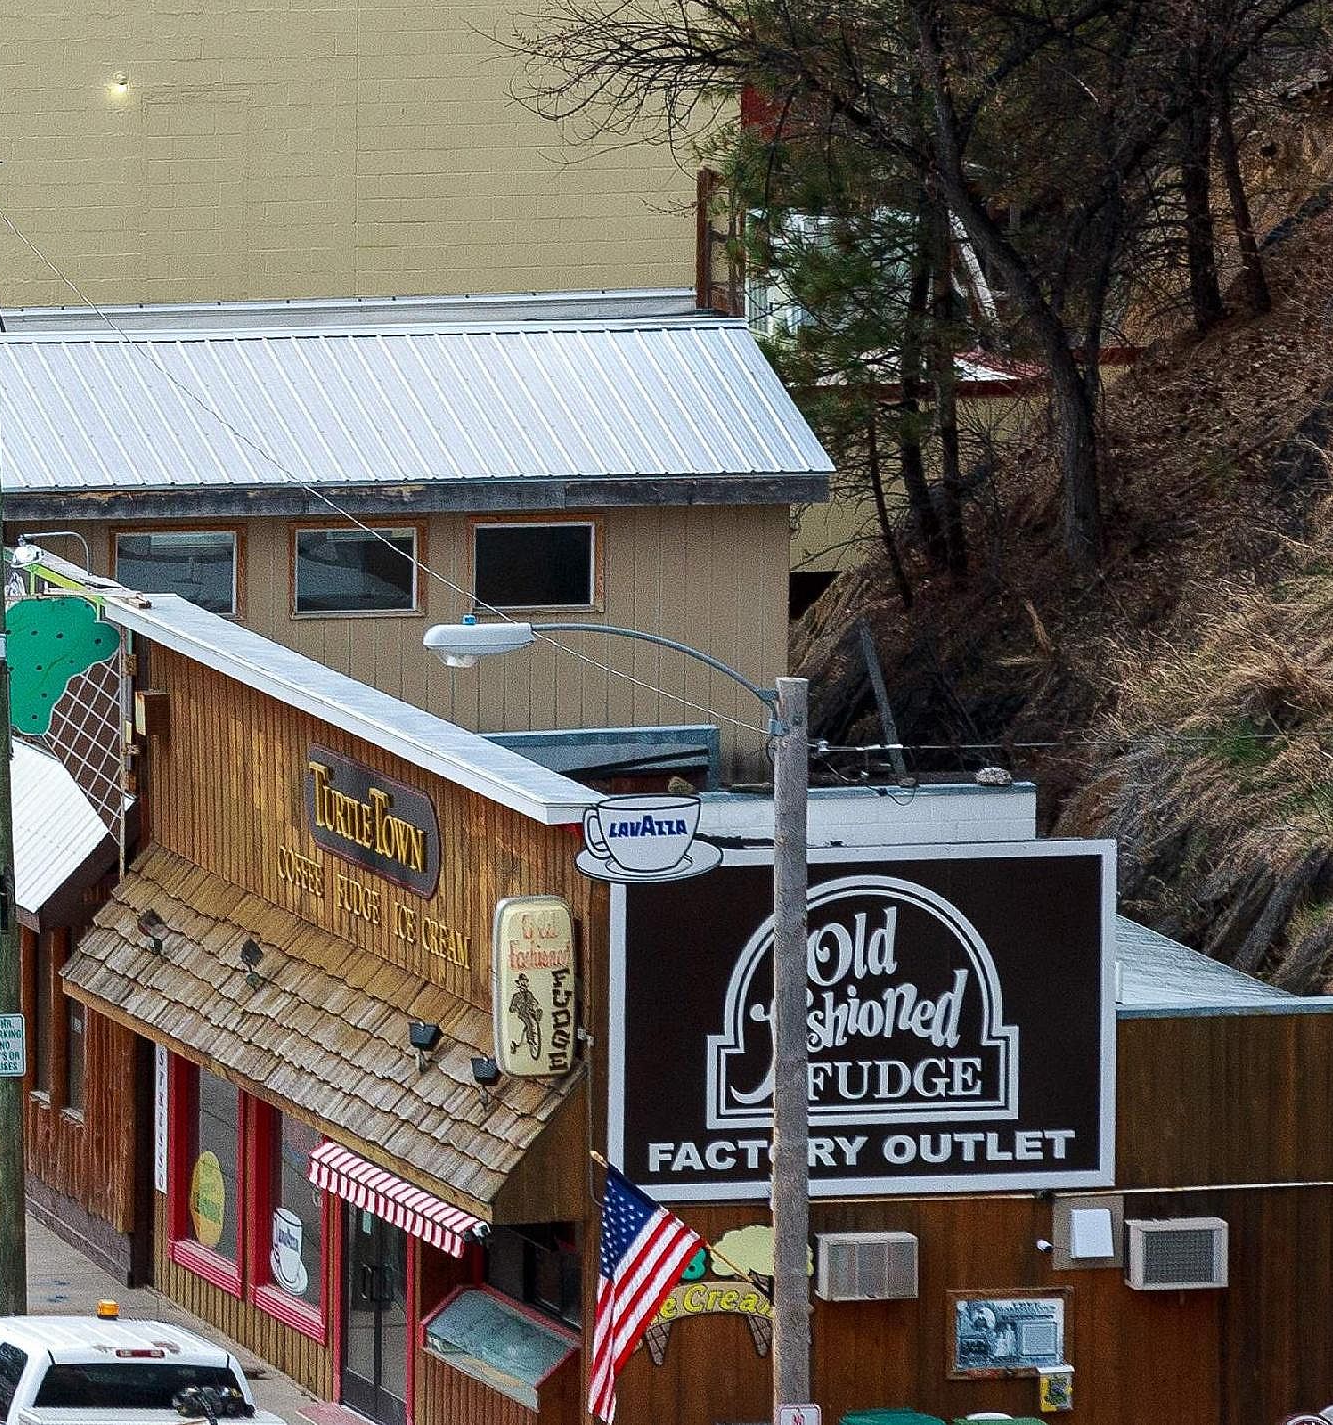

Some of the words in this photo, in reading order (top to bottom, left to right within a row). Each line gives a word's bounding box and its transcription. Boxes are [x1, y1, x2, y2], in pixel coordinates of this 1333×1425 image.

[309, 761, 374, 849] TURTLE
[368, 788, 424, 873] TOWN
[609, 815, 688, 839] LAVAZZA
[277, 845, 323, 897] COFFEE
[336, 873, 381, 924] FUDGE
[394, 902, 416, 944] ICE
[422, 916, 472, 970] CREAM
[807, 906, 898, 987] Old
[0, 1041, 10, 1050] NO
[9, 1052, 20, 1061] OR
[807, 1057, 982, 1101] FUDGE
[648, 1135, 869, 1173] FACTRY
[882, 1129, 1076, 1165] OUTLET
